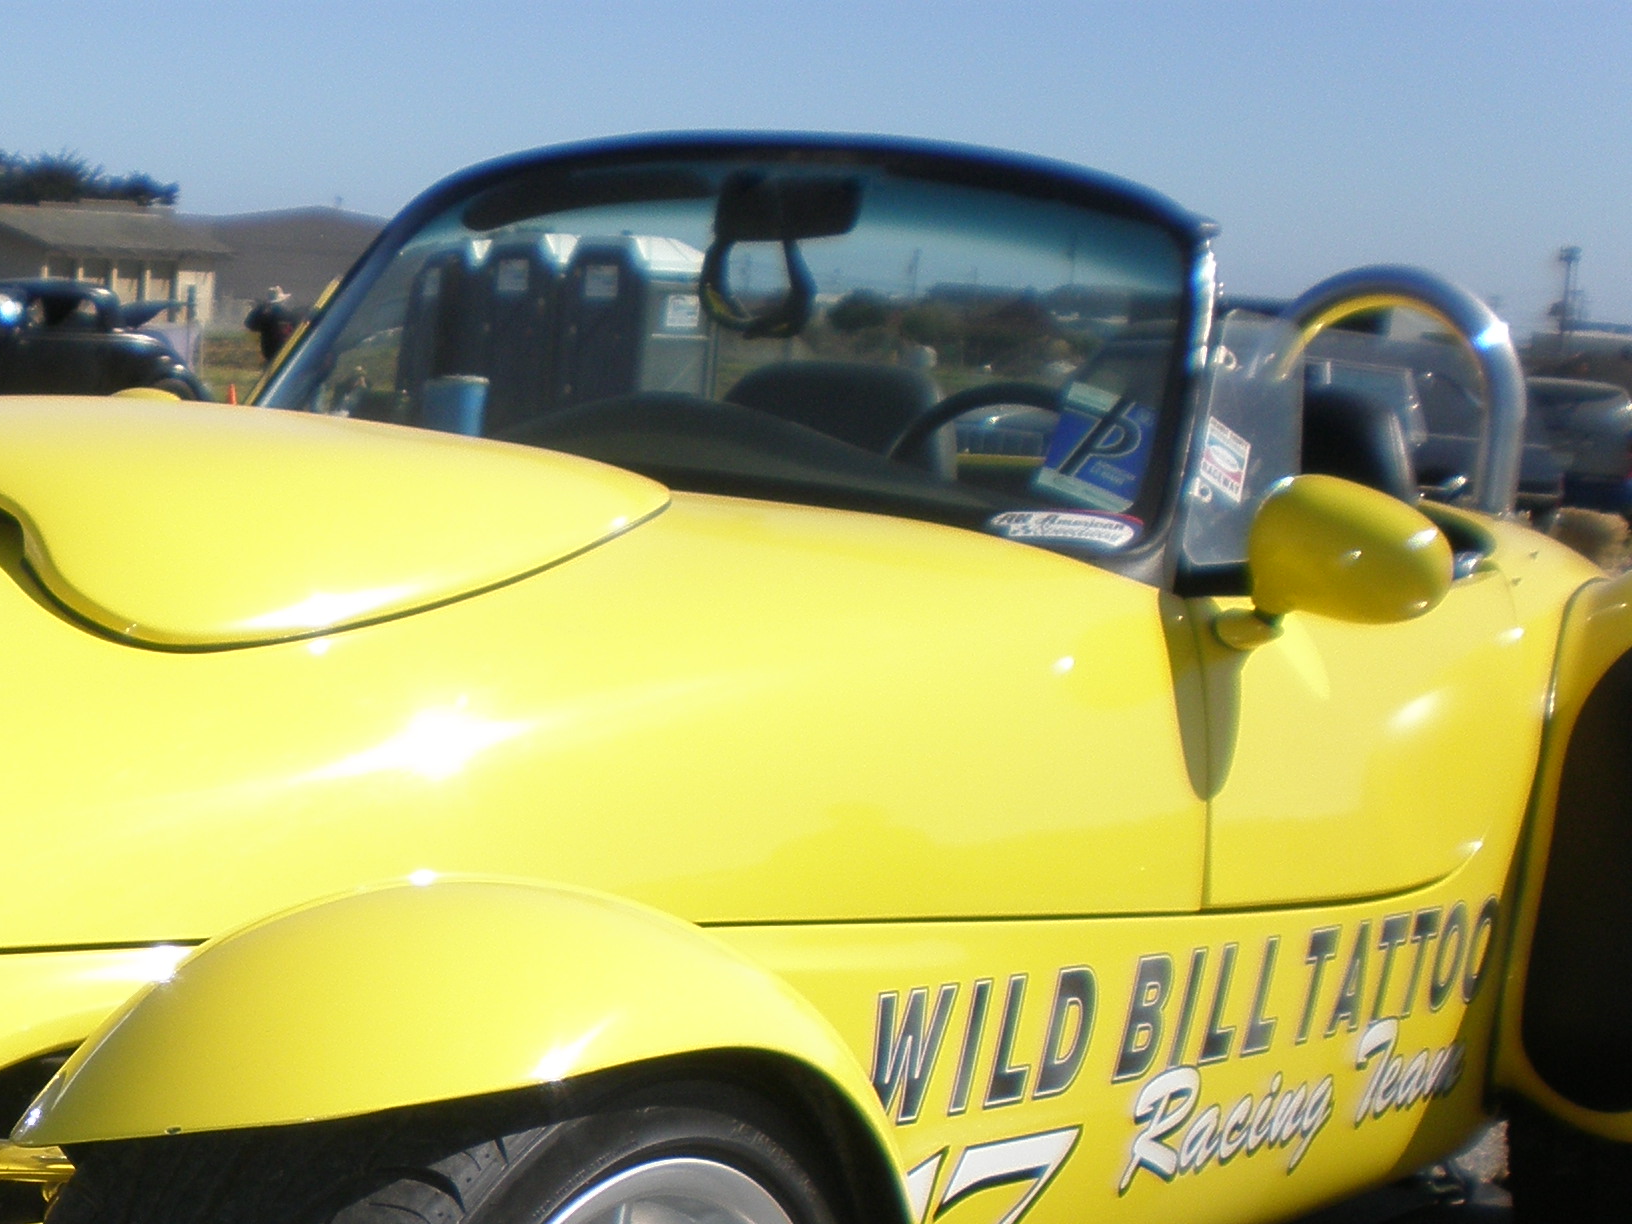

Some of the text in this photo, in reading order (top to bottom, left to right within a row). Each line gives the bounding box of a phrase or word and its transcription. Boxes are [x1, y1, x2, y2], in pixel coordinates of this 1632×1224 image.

[870, 894, 1501, 1127] WILD BILL TATTOO
[1118, 1016, 1468, 1198] Racing Team
